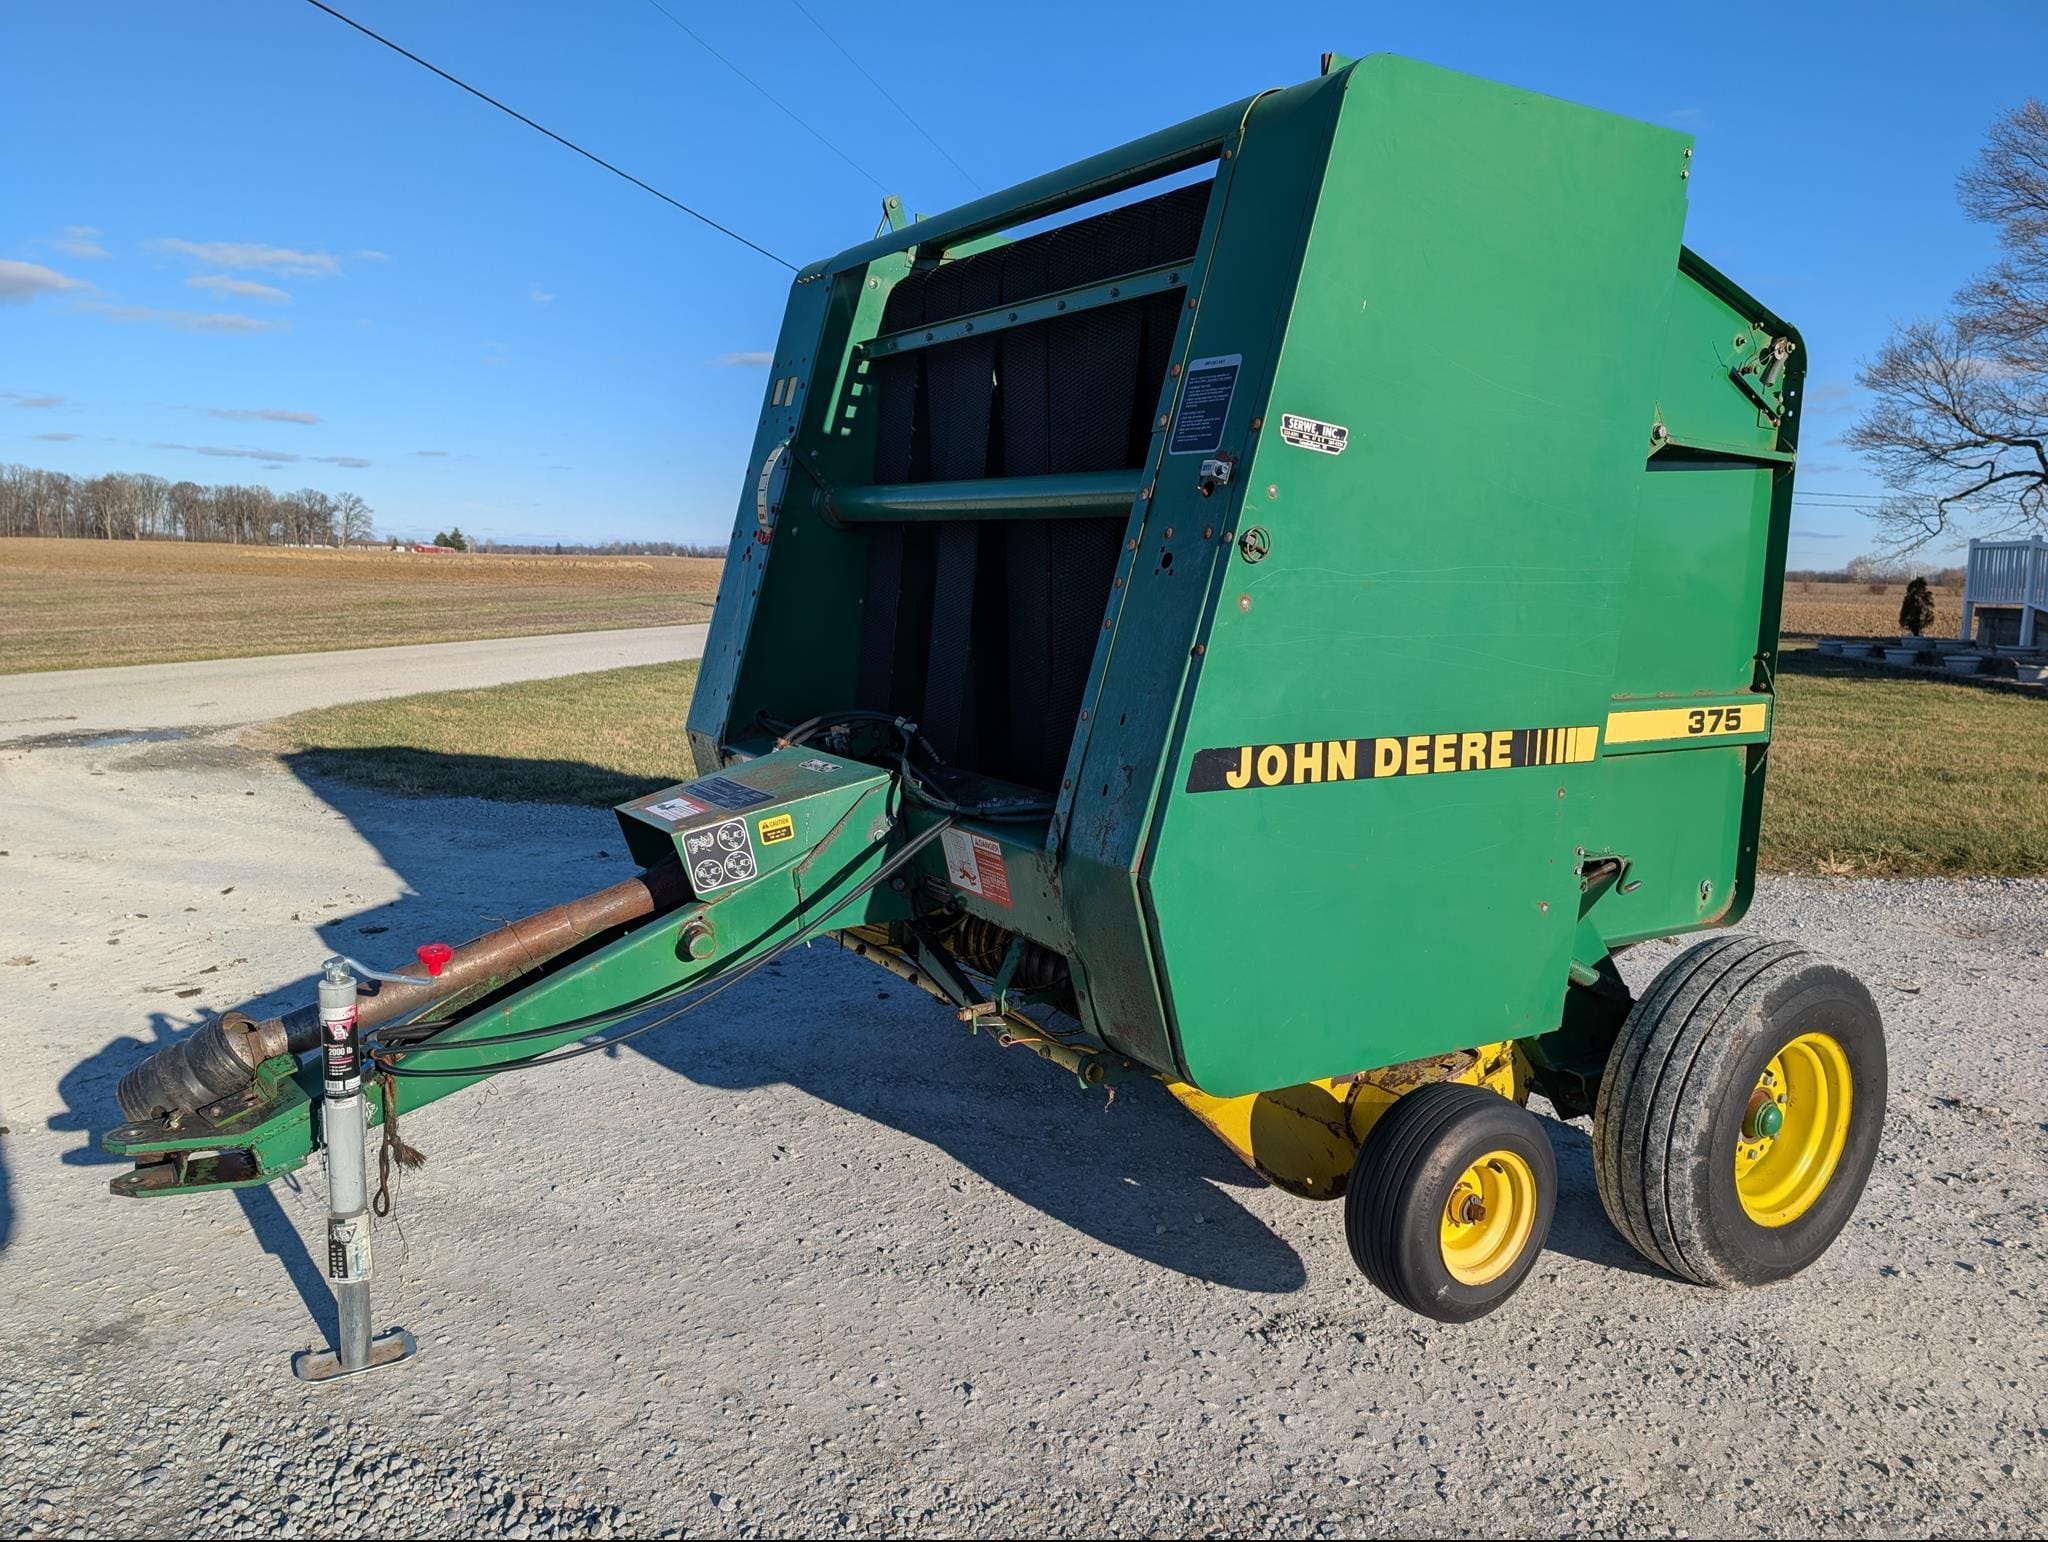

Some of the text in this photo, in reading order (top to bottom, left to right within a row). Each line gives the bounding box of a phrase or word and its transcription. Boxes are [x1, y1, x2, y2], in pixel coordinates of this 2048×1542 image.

[1288, 418, 1319, 435] SERWE,
[1322, 427, 1340, 439] INC.
[1687, 707, 1742, 734] 375
[1225, 730, 1513, 789] JOHN DEERE
[769, 818, 789, 827] CAUTION
[328, 1047, 345, 1056] 2000
